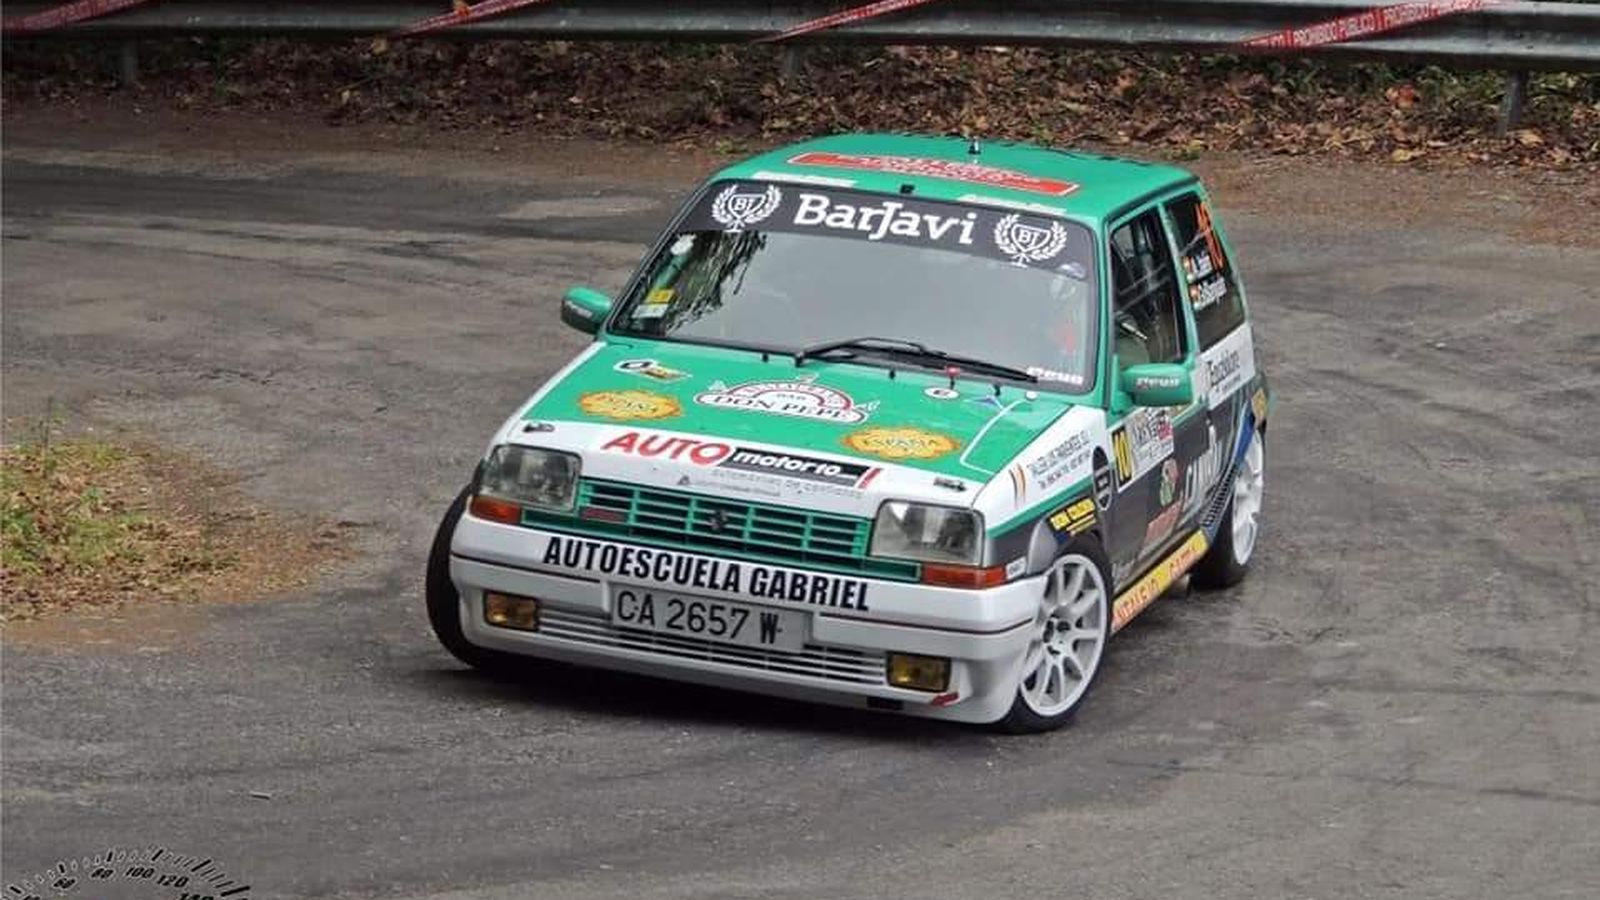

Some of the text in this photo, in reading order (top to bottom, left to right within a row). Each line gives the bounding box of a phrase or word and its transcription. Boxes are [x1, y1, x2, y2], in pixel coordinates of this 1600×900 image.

[793, 193, 978, 245] BarJavi
[714, 394, 775, 409] DON
[602, 432, 732, 466] AUTO
[542, 537, 869, 611] AUTOESCUELA GABRIEL
[617, 590, 655, 627] CA
[666, 598, 750, 639] 2657
